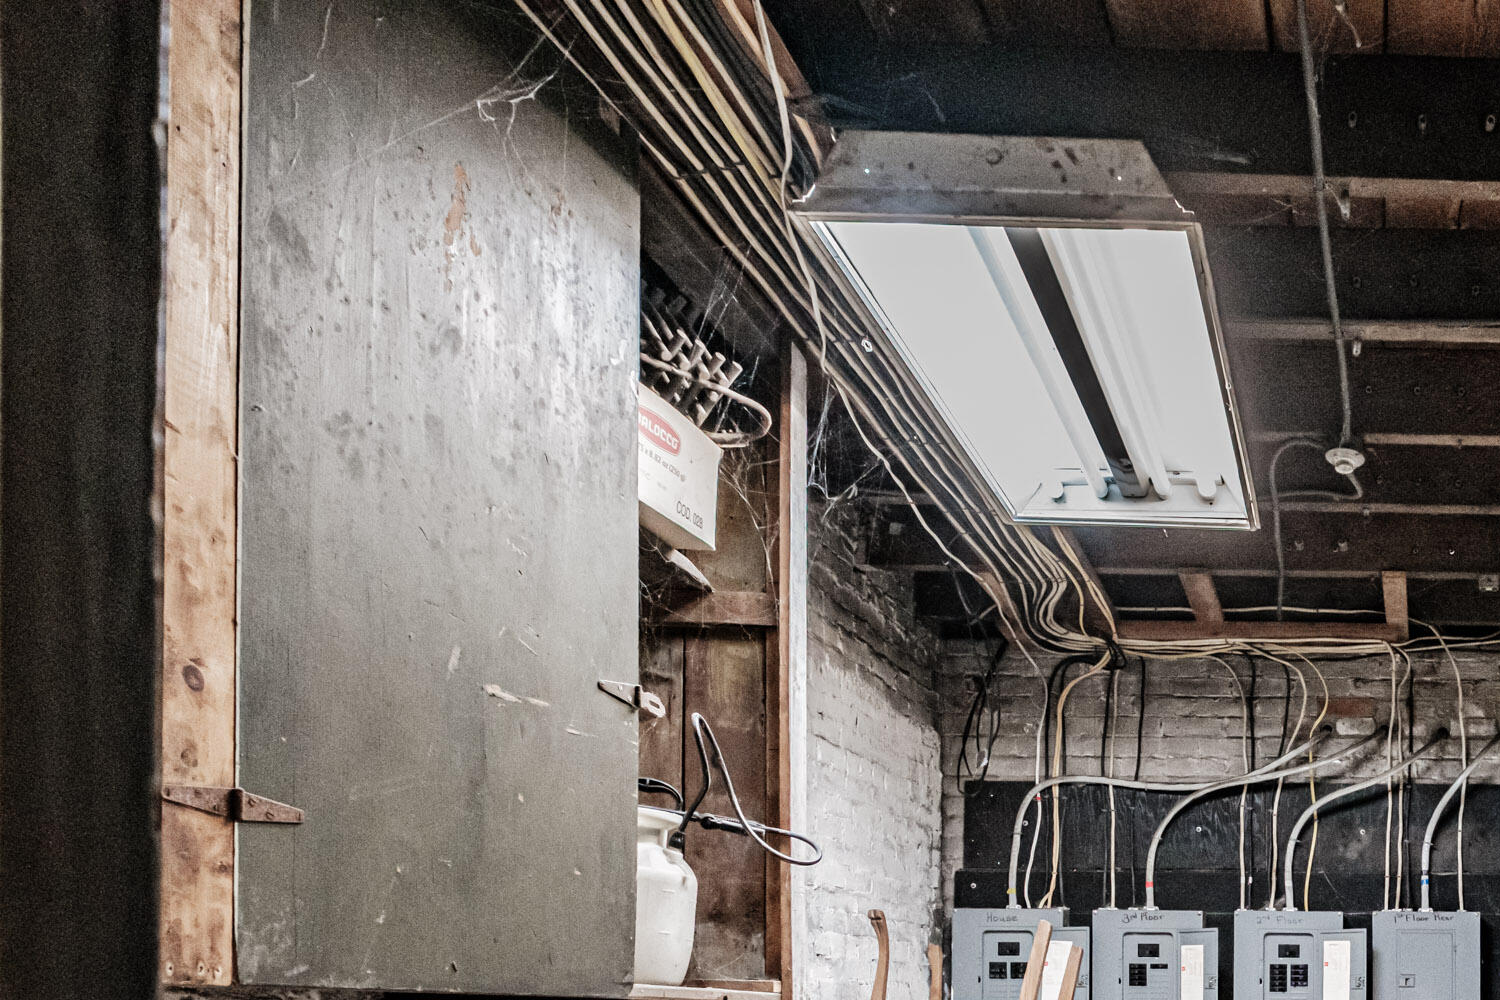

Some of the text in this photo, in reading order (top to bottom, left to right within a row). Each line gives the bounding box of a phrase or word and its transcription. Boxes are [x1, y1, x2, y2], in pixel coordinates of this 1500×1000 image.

[676, 500, 692, 523] COD.
[986, 911, 1018, 923] House
[1405, 913, 1430, 922] Floor
